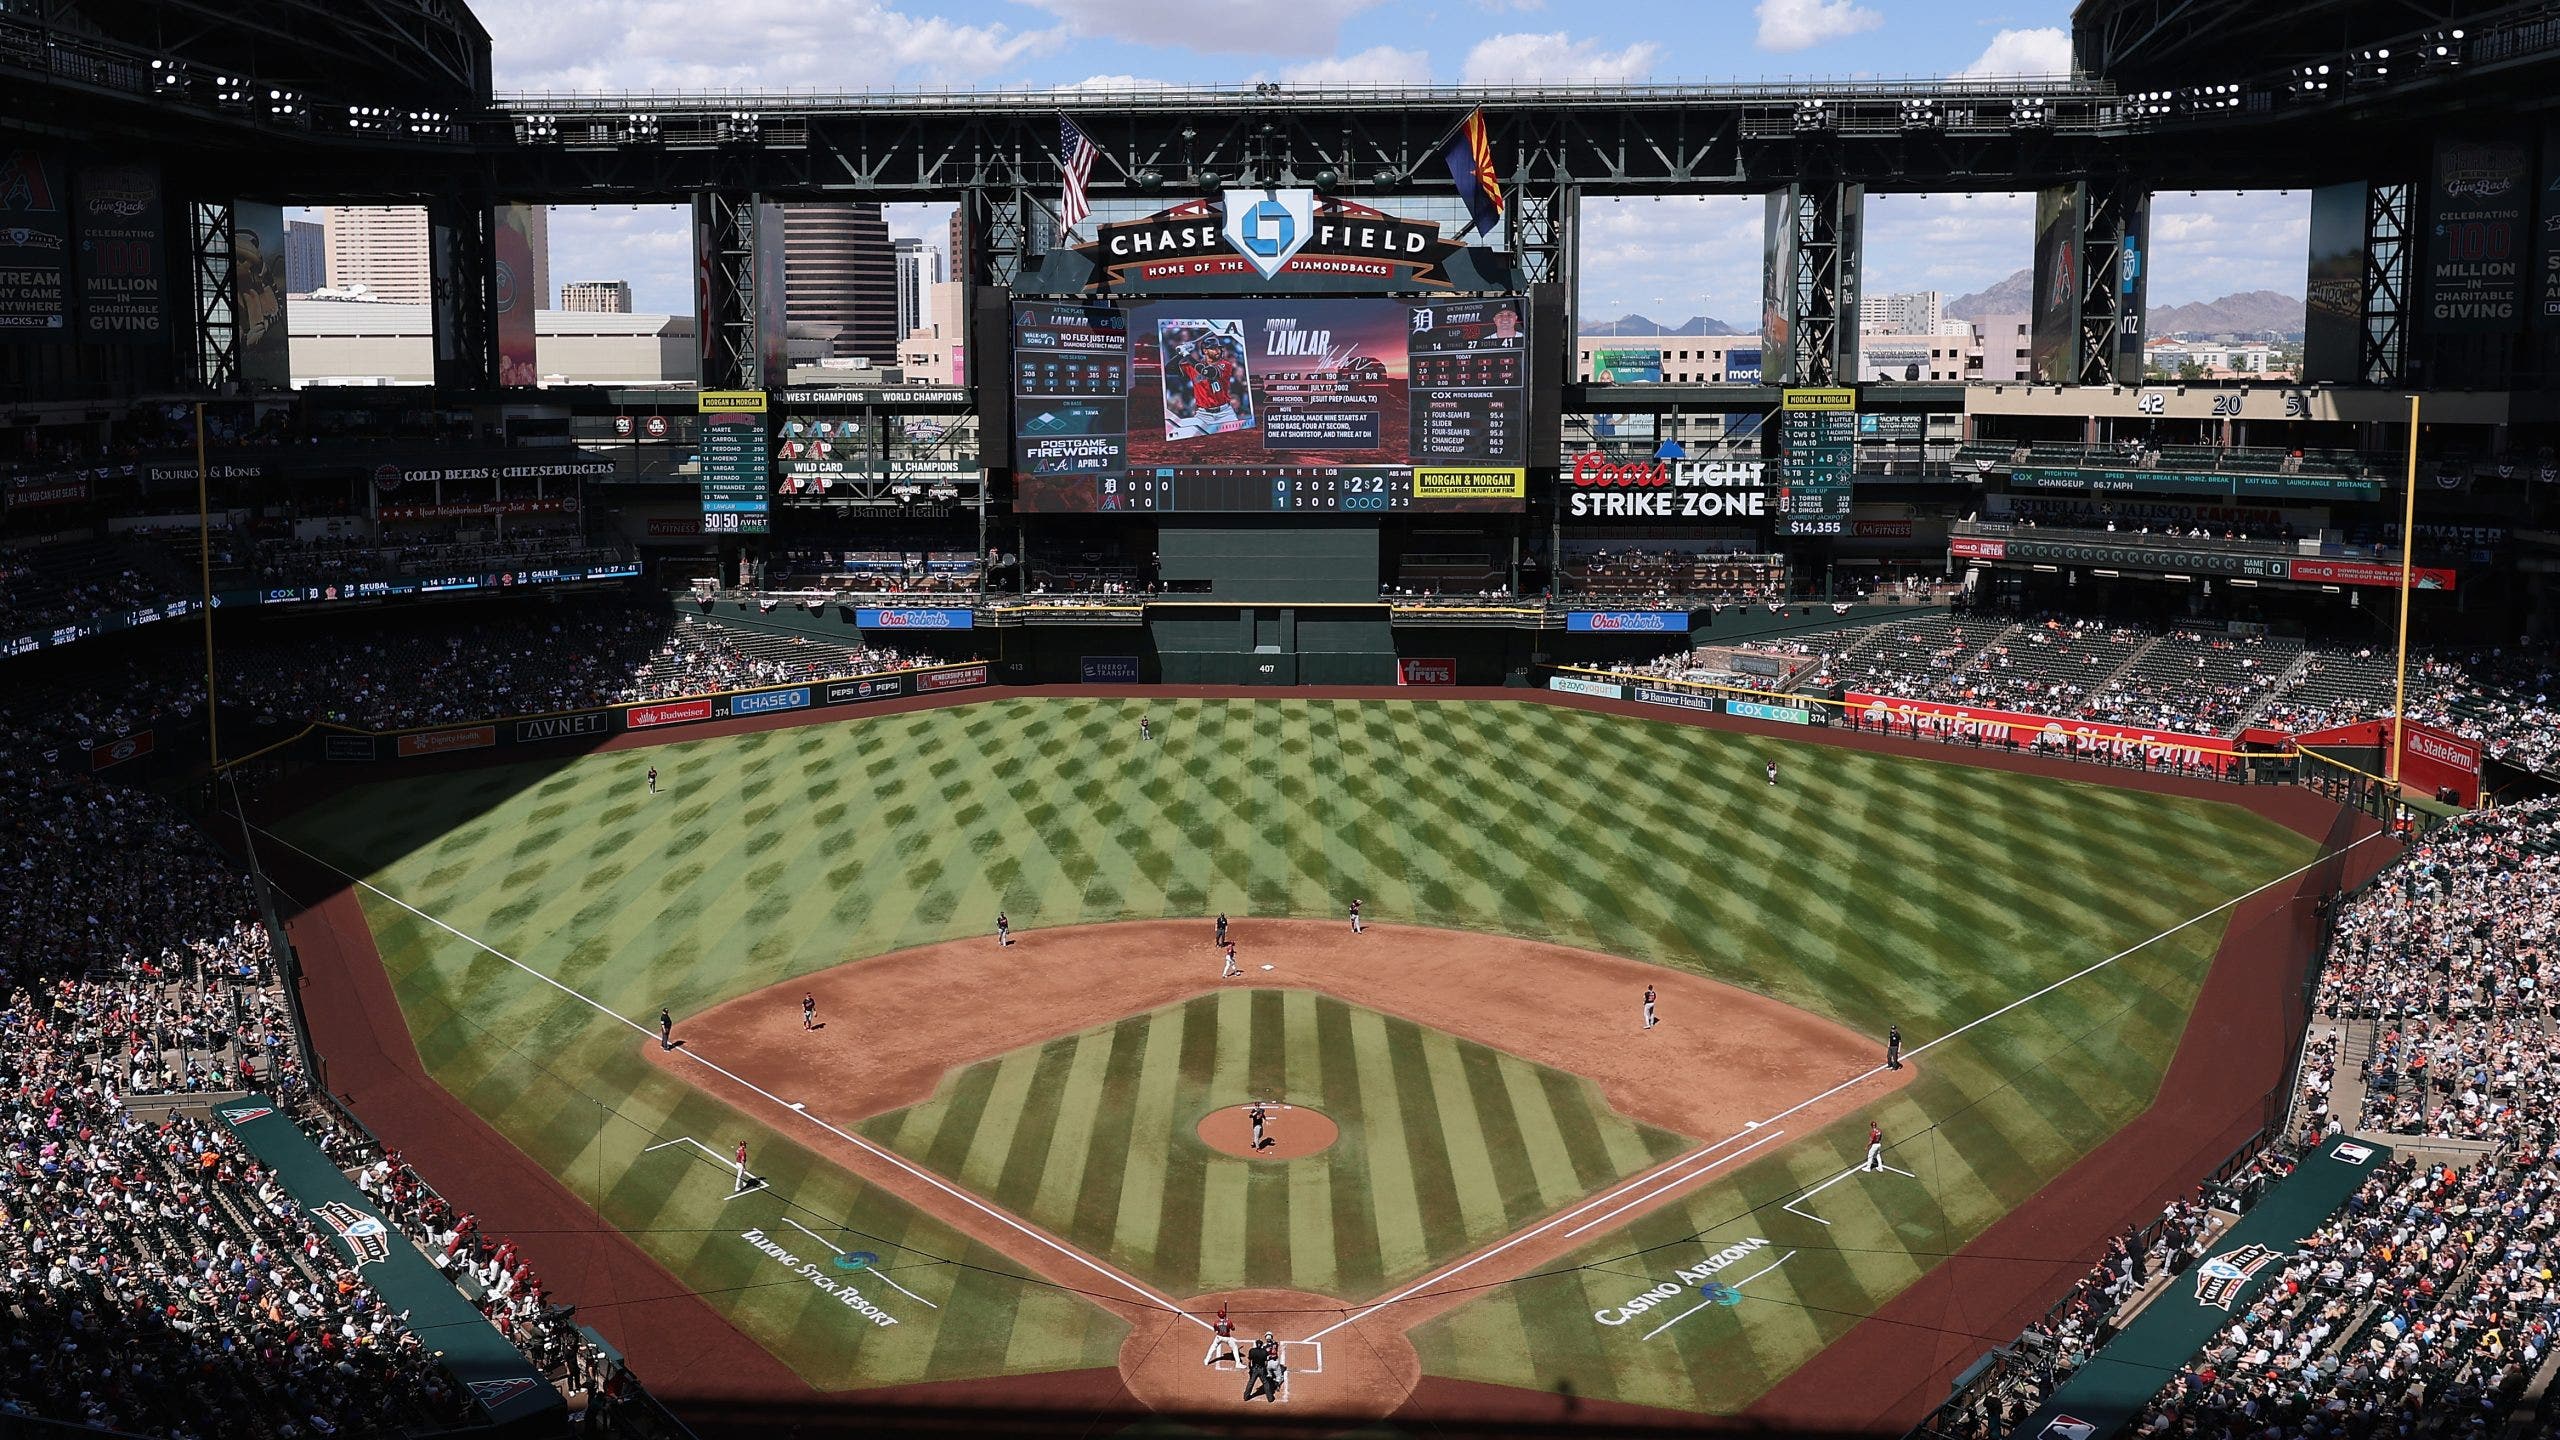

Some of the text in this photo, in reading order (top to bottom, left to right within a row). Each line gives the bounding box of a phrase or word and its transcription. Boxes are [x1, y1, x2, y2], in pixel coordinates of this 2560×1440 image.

[2440, 210, 2519, 221] CELEBRATING
[84, 229, 154, 239] CELEBRATING
[1109, 225, 1426, 256] CHASE FIELD
[1148, 260, 1387, 277] HOME OF THE DIAMONDBACKS
[2436, 263, 2516, 277] MILLION
[87, 278, 158, 291] MILLION
[2467, 280, 2481, 289] IN
[117, 294, 129, 302] IN
[2435, 291, 2514, 301] CHARITABLE
[89, 305, 159, 314] CHARITABLE
[2434, 304, 2513, 319] GIVING
[90, 317, 159, 330] GIVING
[1446, 313, 1481, 324] SKUBAL
[1263, 319, 1297, 332] JORDAN
[1061, 333, 1125, 344] NO FLEX JUST FAITH
[1267, 331, 1331, 356] LAWLAR
[1432, 343, 1442, 351] 14
[1468, 341, 1478, 349] 27
[1501, 338, 1514, 348] 41
[706, 398, 760, 406] MORGAN & MORGAN
[786, 392, 811, 402] WEST
[814, 392, 864, 402] CHAMPIONS
[882, 392, 964, 401] WORLD CHAMPIONS
[1790, 396, 1816, 404] MORGAN
[1823, 396, 1848, 404] MORGAN
[2138, 393, 2165, 414] 42
[2213, 395, 2243, 415] 20
[2286, 396, 2312, 417] 51
[1268, 414, 1282, 422] LAST
[1306, 414, 1324, 422] MADE
[1324, 414, 1338, 422] NINE
[1338, 414, 1359, 422] STARTS
[1041, 439, 1107, 449] POSTGAME
[1028, 446, 1119, 459] FIREWORKS
[1827, 454, 1833, 463] 8
[794, 463, 843, 472] WILD CARD
[892, 463, 959, 472] NL CHAMPIONS
[1078, 458, 1108, 469] APRIL 3
[1571, 450, 1669, 487] Coors
[404, 470, 440, 482] COLD
[445, 468, 490, 480] BEERS
[491, 468, 499, 478] &
[502, 462, 616, 478] CHEESEBURGERS
[2105, 472, 2125, 480] SPEED
[1128, 477, 1410, 493] 0 0 0 0 2 0 2 B 2 S 2 2 4
[1424, 474, 1511, 486] MORGAN & MORGAN
[2038, 479, 2134, 490] CHANGEUP 86.7 MPH
[2336, 481, 2372, 490] DISTANCE
[1571, 492, 1765, 517] STRIKE ZONE
[2010, 498, 2096, 516] ESTRELLA
[2120, 504, 2191, 520] JALISCO
[854, 506, 950, 518] Banner Health
[1791, 520, 1841, 535] $14,355
[1980, 547, 2003, 557] METER
[2244, 559, 2264, 568] GAME
[2244, 562, 2281, 576] TOTAL 0
[139, 614, 161, 625] CARROLL
[20, 642, 40, 654] MARTE
[1097, 663, 1128, 671] ENERGY
[1260, 664, 1275, 673] 407
[1404, 661, 1449, 684] fry's
[831, 682, 898, 698] PEPSI PEPSI
[740, 694, 787, 709] CHASE
[1650, 692, 1707, 709] Banner Health
[660, 708, 705, 721] Budweiser
[714, 708, 729, 717] 374
[1736, 704, 1799, 722] COX COX
[1810, 713, 1826, 724] 374
[432, 732, 480, 747] Dignity Health
[331, 1207, 357, 1224] CHASE
[362, 1236, 381, 1256] FIELD
[2232, 1248, 2259, 1267] FIELD
[1594, 1236, 1771, 1326] CASINO ARIZONA
[2204, 1278, 2226, 1300] CHASE
